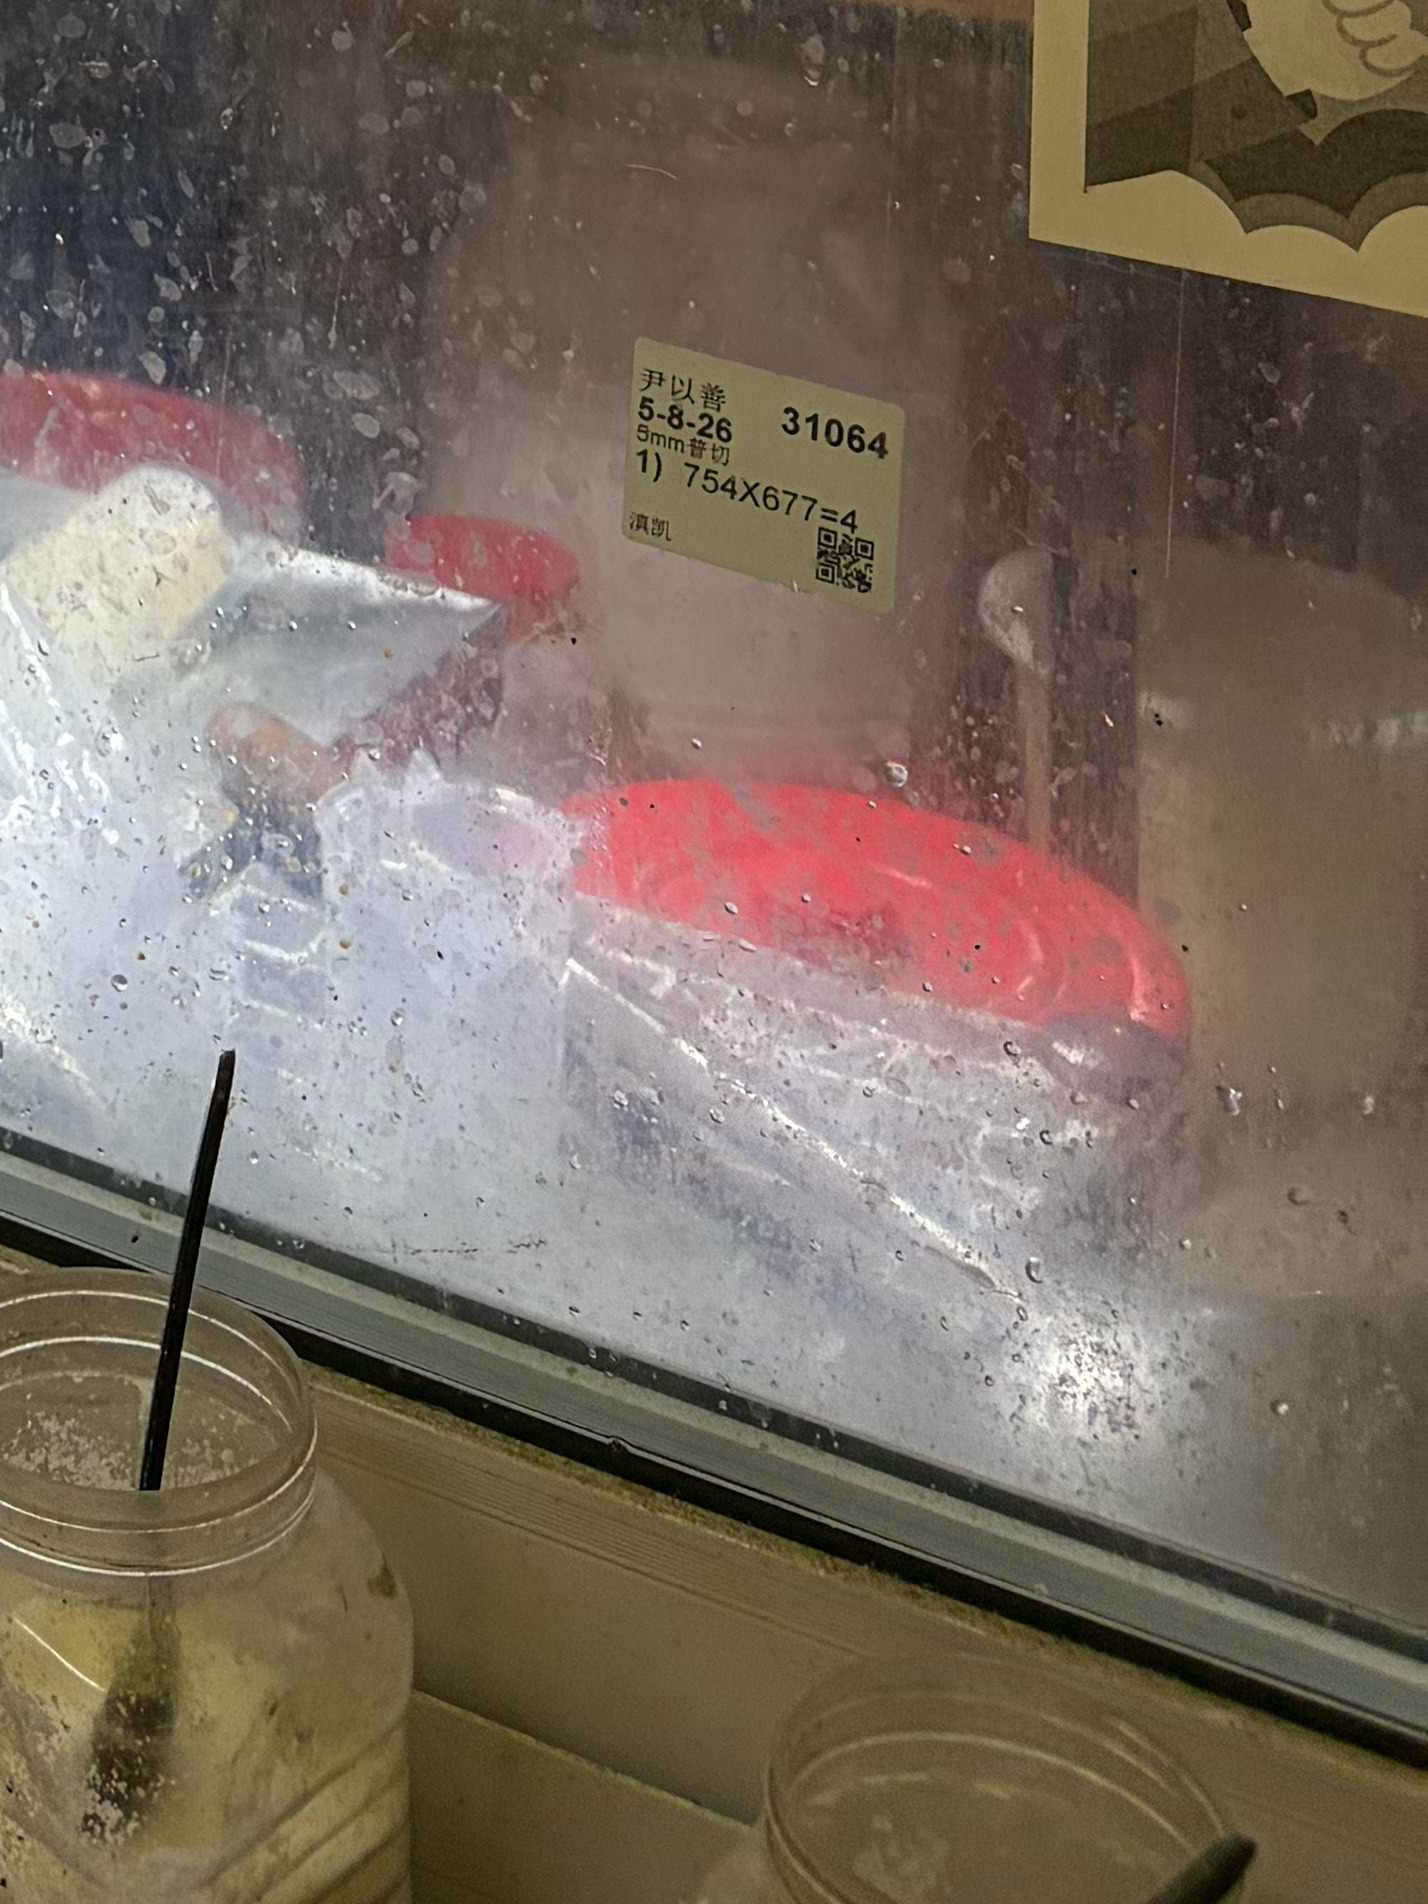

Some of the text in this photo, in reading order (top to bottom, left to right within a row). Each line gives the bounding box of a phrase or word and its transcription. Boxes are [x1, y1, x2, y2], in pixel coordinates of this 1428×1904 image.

[638, 368, 726, 413] 尹以善
[638, 395, 732, 443] 5-8-26
[781, 406, 889, 460] 31064
[636, 423, 731, 467] 5mm普切
[636, 448, 859, 535] 1) 754X677=4
